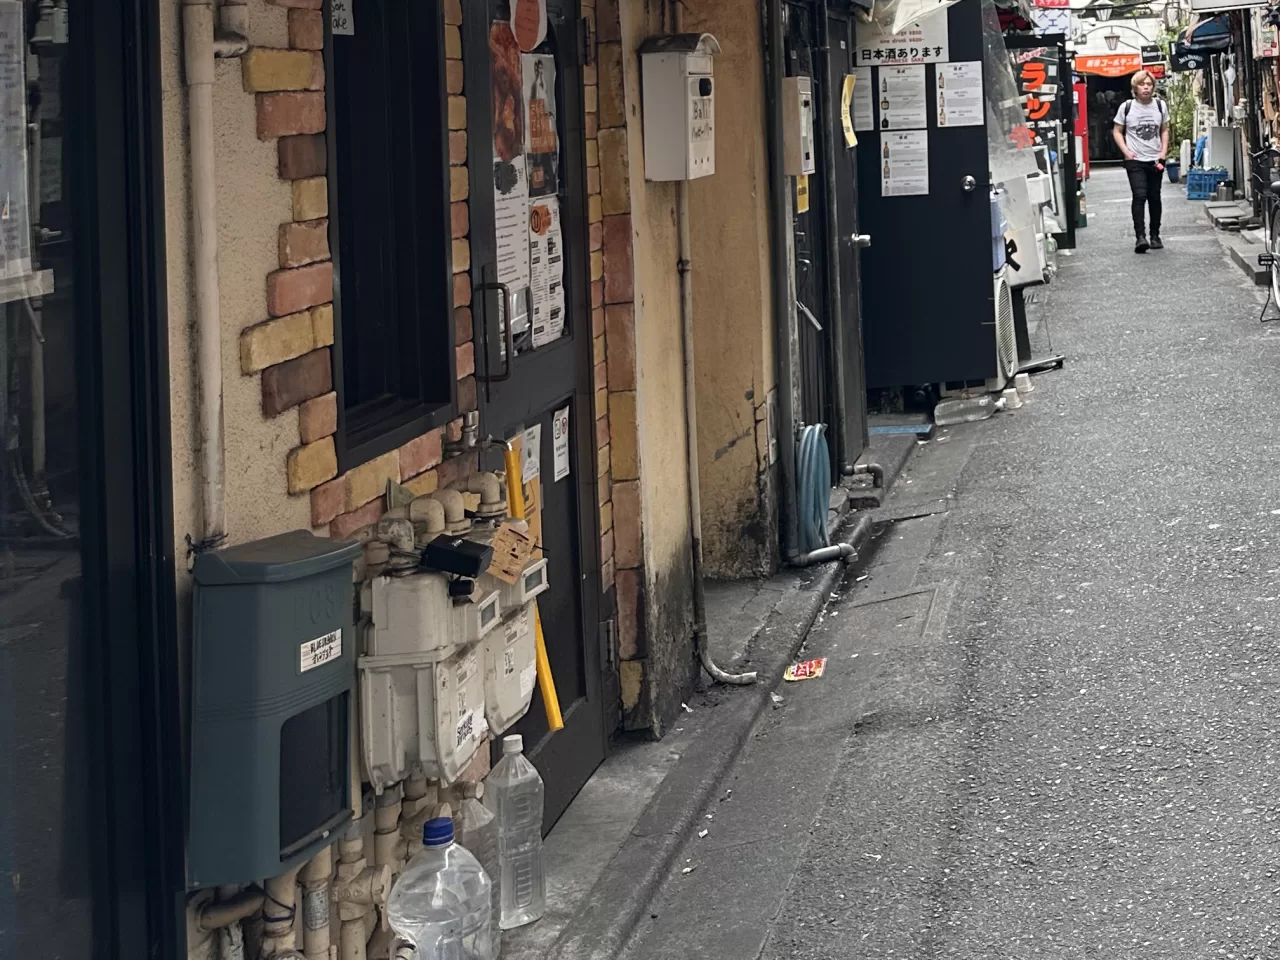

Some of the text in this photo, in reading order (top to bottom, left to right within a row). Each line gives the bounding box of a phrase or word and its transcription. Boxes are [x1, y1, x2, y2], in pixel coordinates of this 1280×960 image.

[861, 46, 943, 60] 日本酒あります
